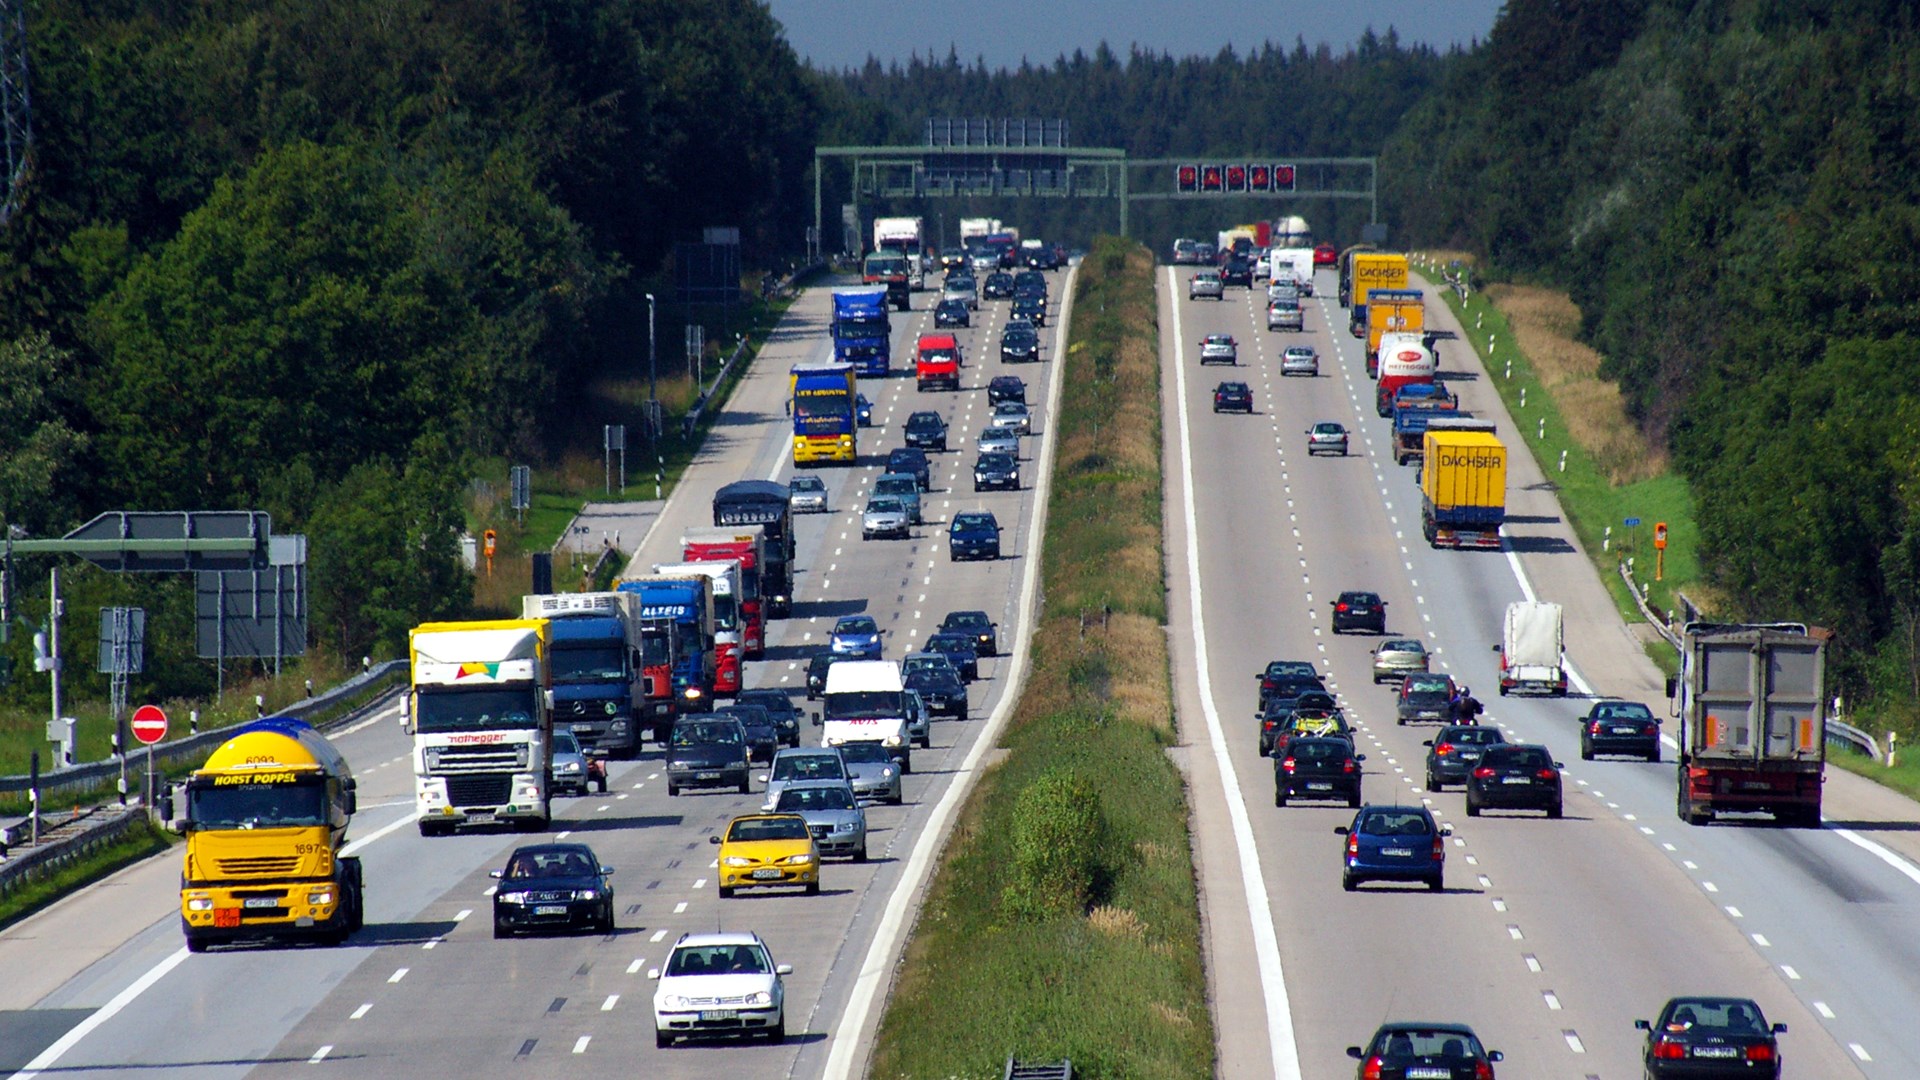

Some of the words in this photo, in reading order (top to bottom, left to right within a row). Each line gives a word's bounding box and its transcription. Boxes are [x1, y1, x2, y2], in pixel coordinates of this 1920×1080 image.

[1359, 267, 1405, 278] DACHSER
[1441, 455, 1501, 469] DACHSER
[246, 756, 275, 764] 6093
[214, 775, 253, 786] HORST
[253, 773, 297, 784] POPPEL
[294, 843, 320, 855] 1697
